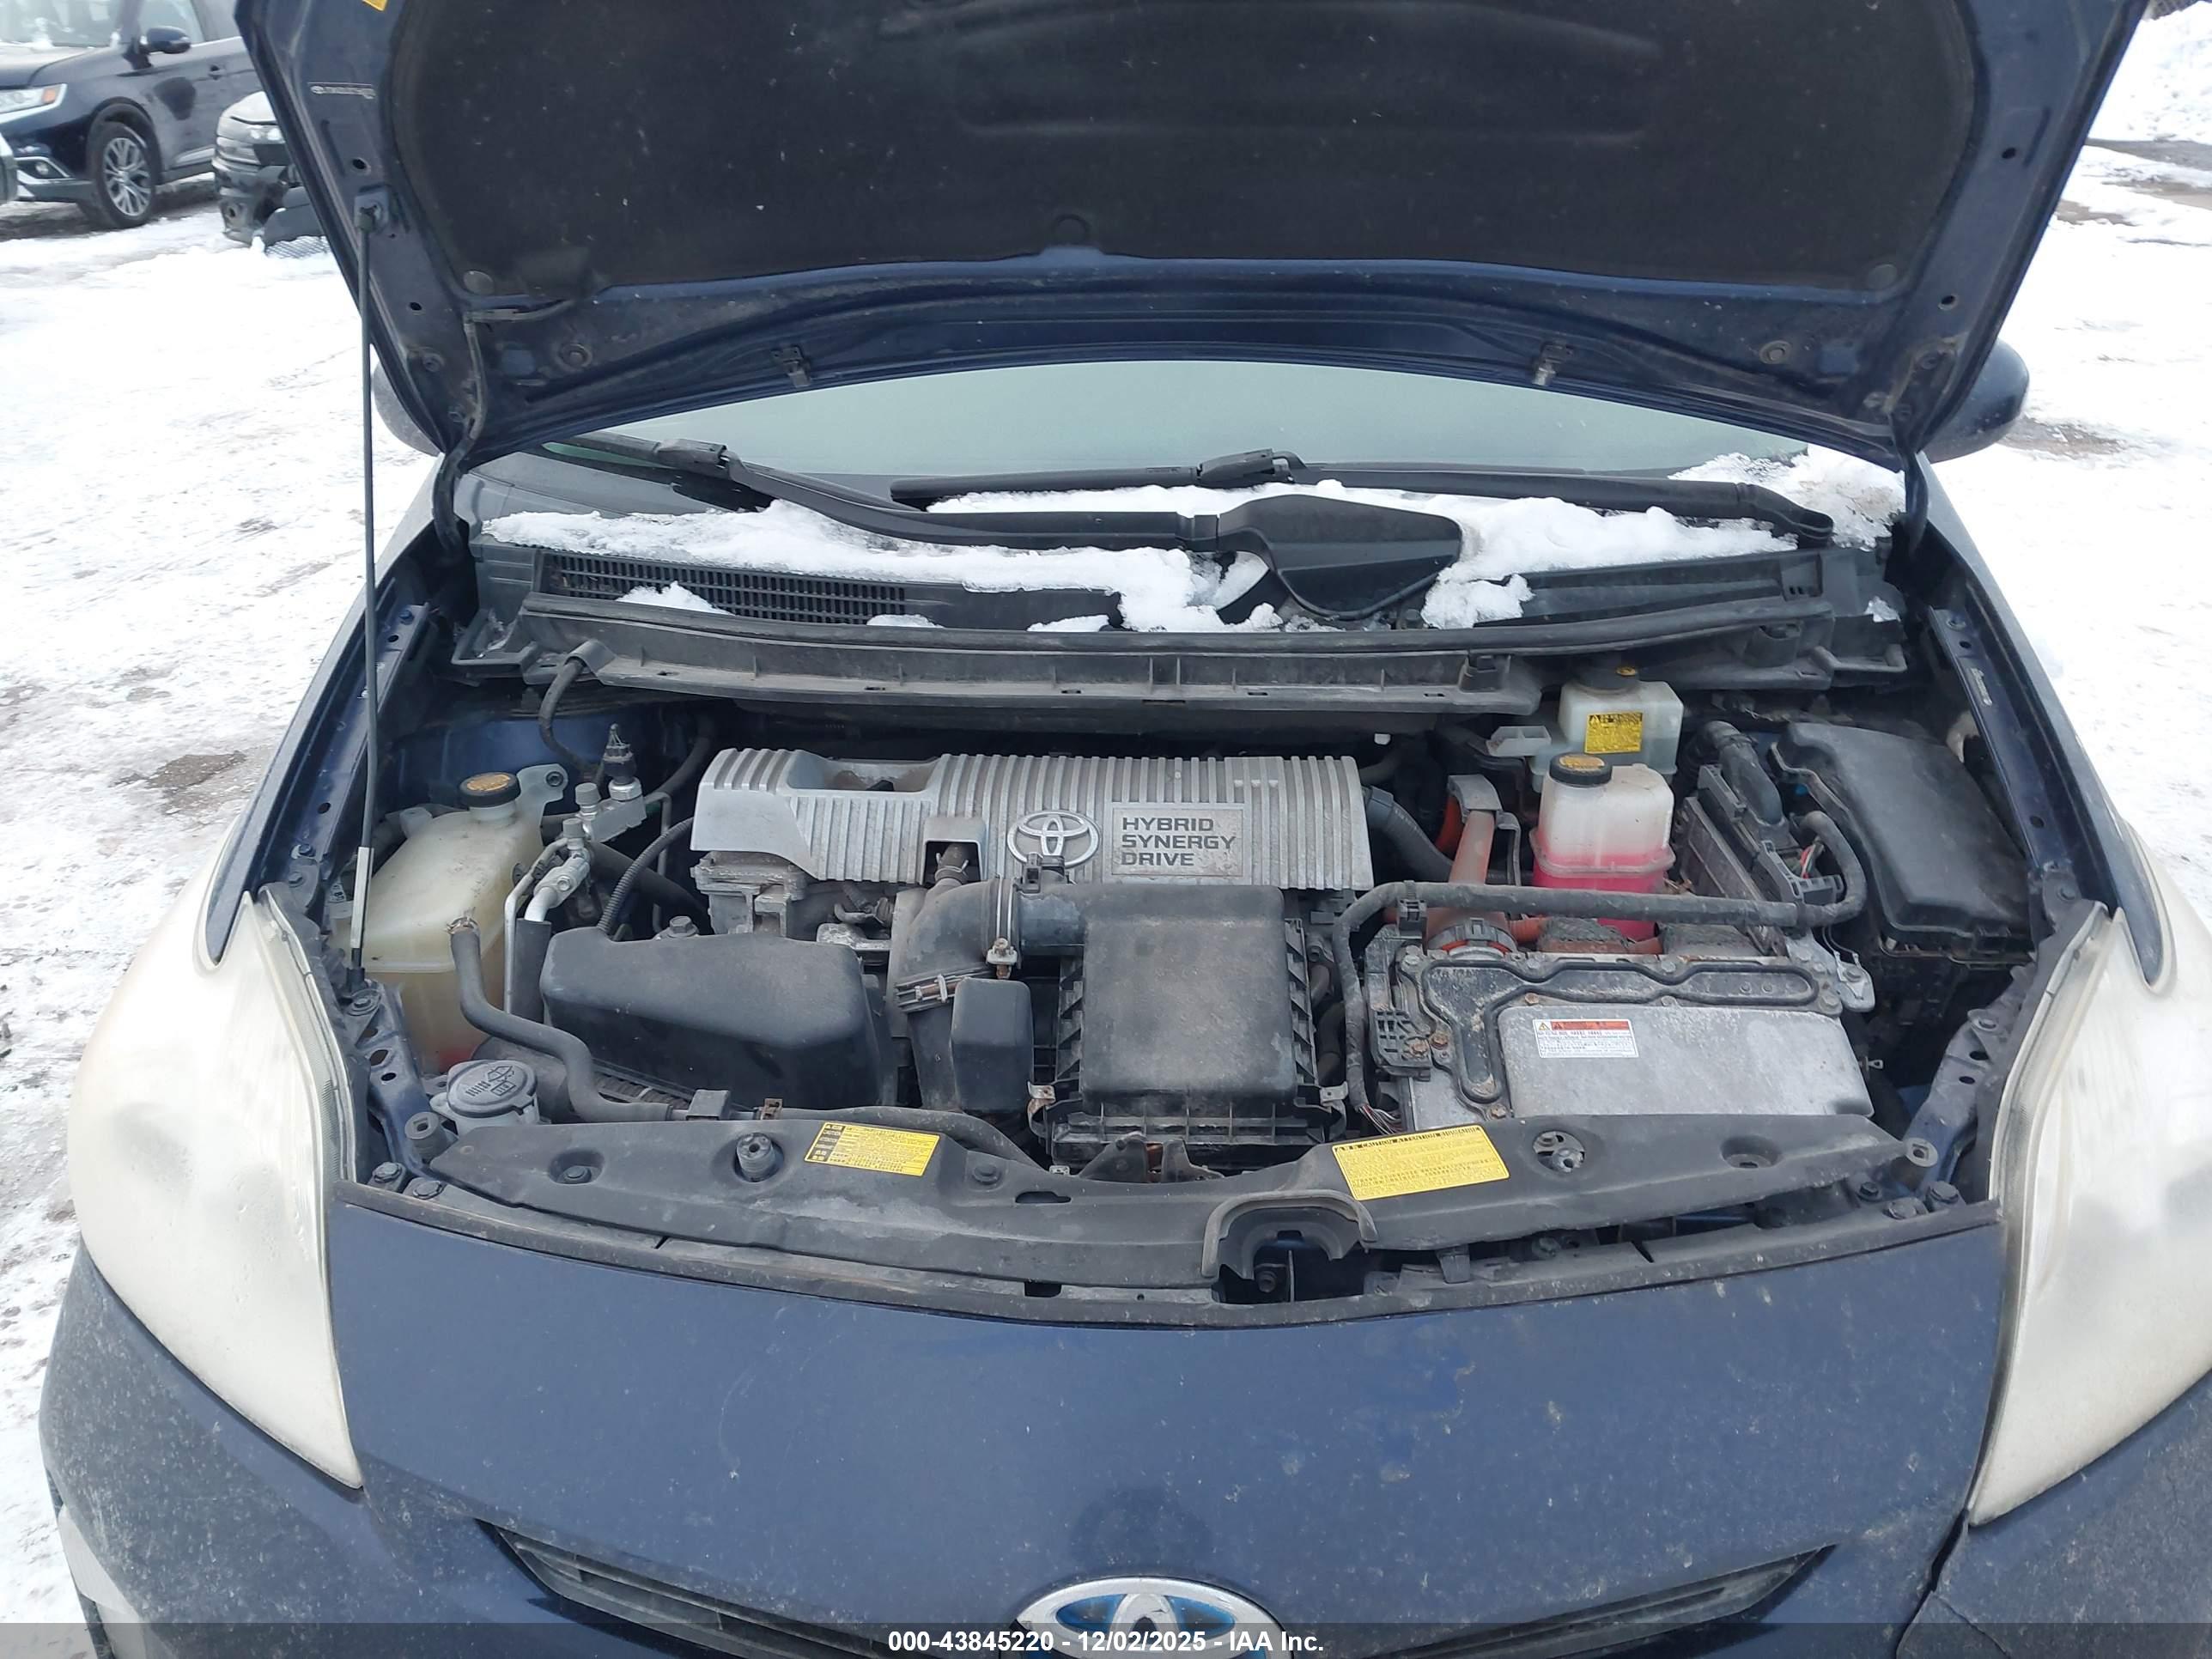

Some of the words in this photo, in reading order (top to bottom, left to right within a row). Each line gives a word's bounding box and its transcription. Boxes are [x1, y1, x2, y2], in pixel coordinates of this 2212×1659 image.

[1122, 817, 1213, 831] HYBRID
[1121, 835, 1236, 848] SYNERGY
[1122, 853, 1195, 866] DRIVE
